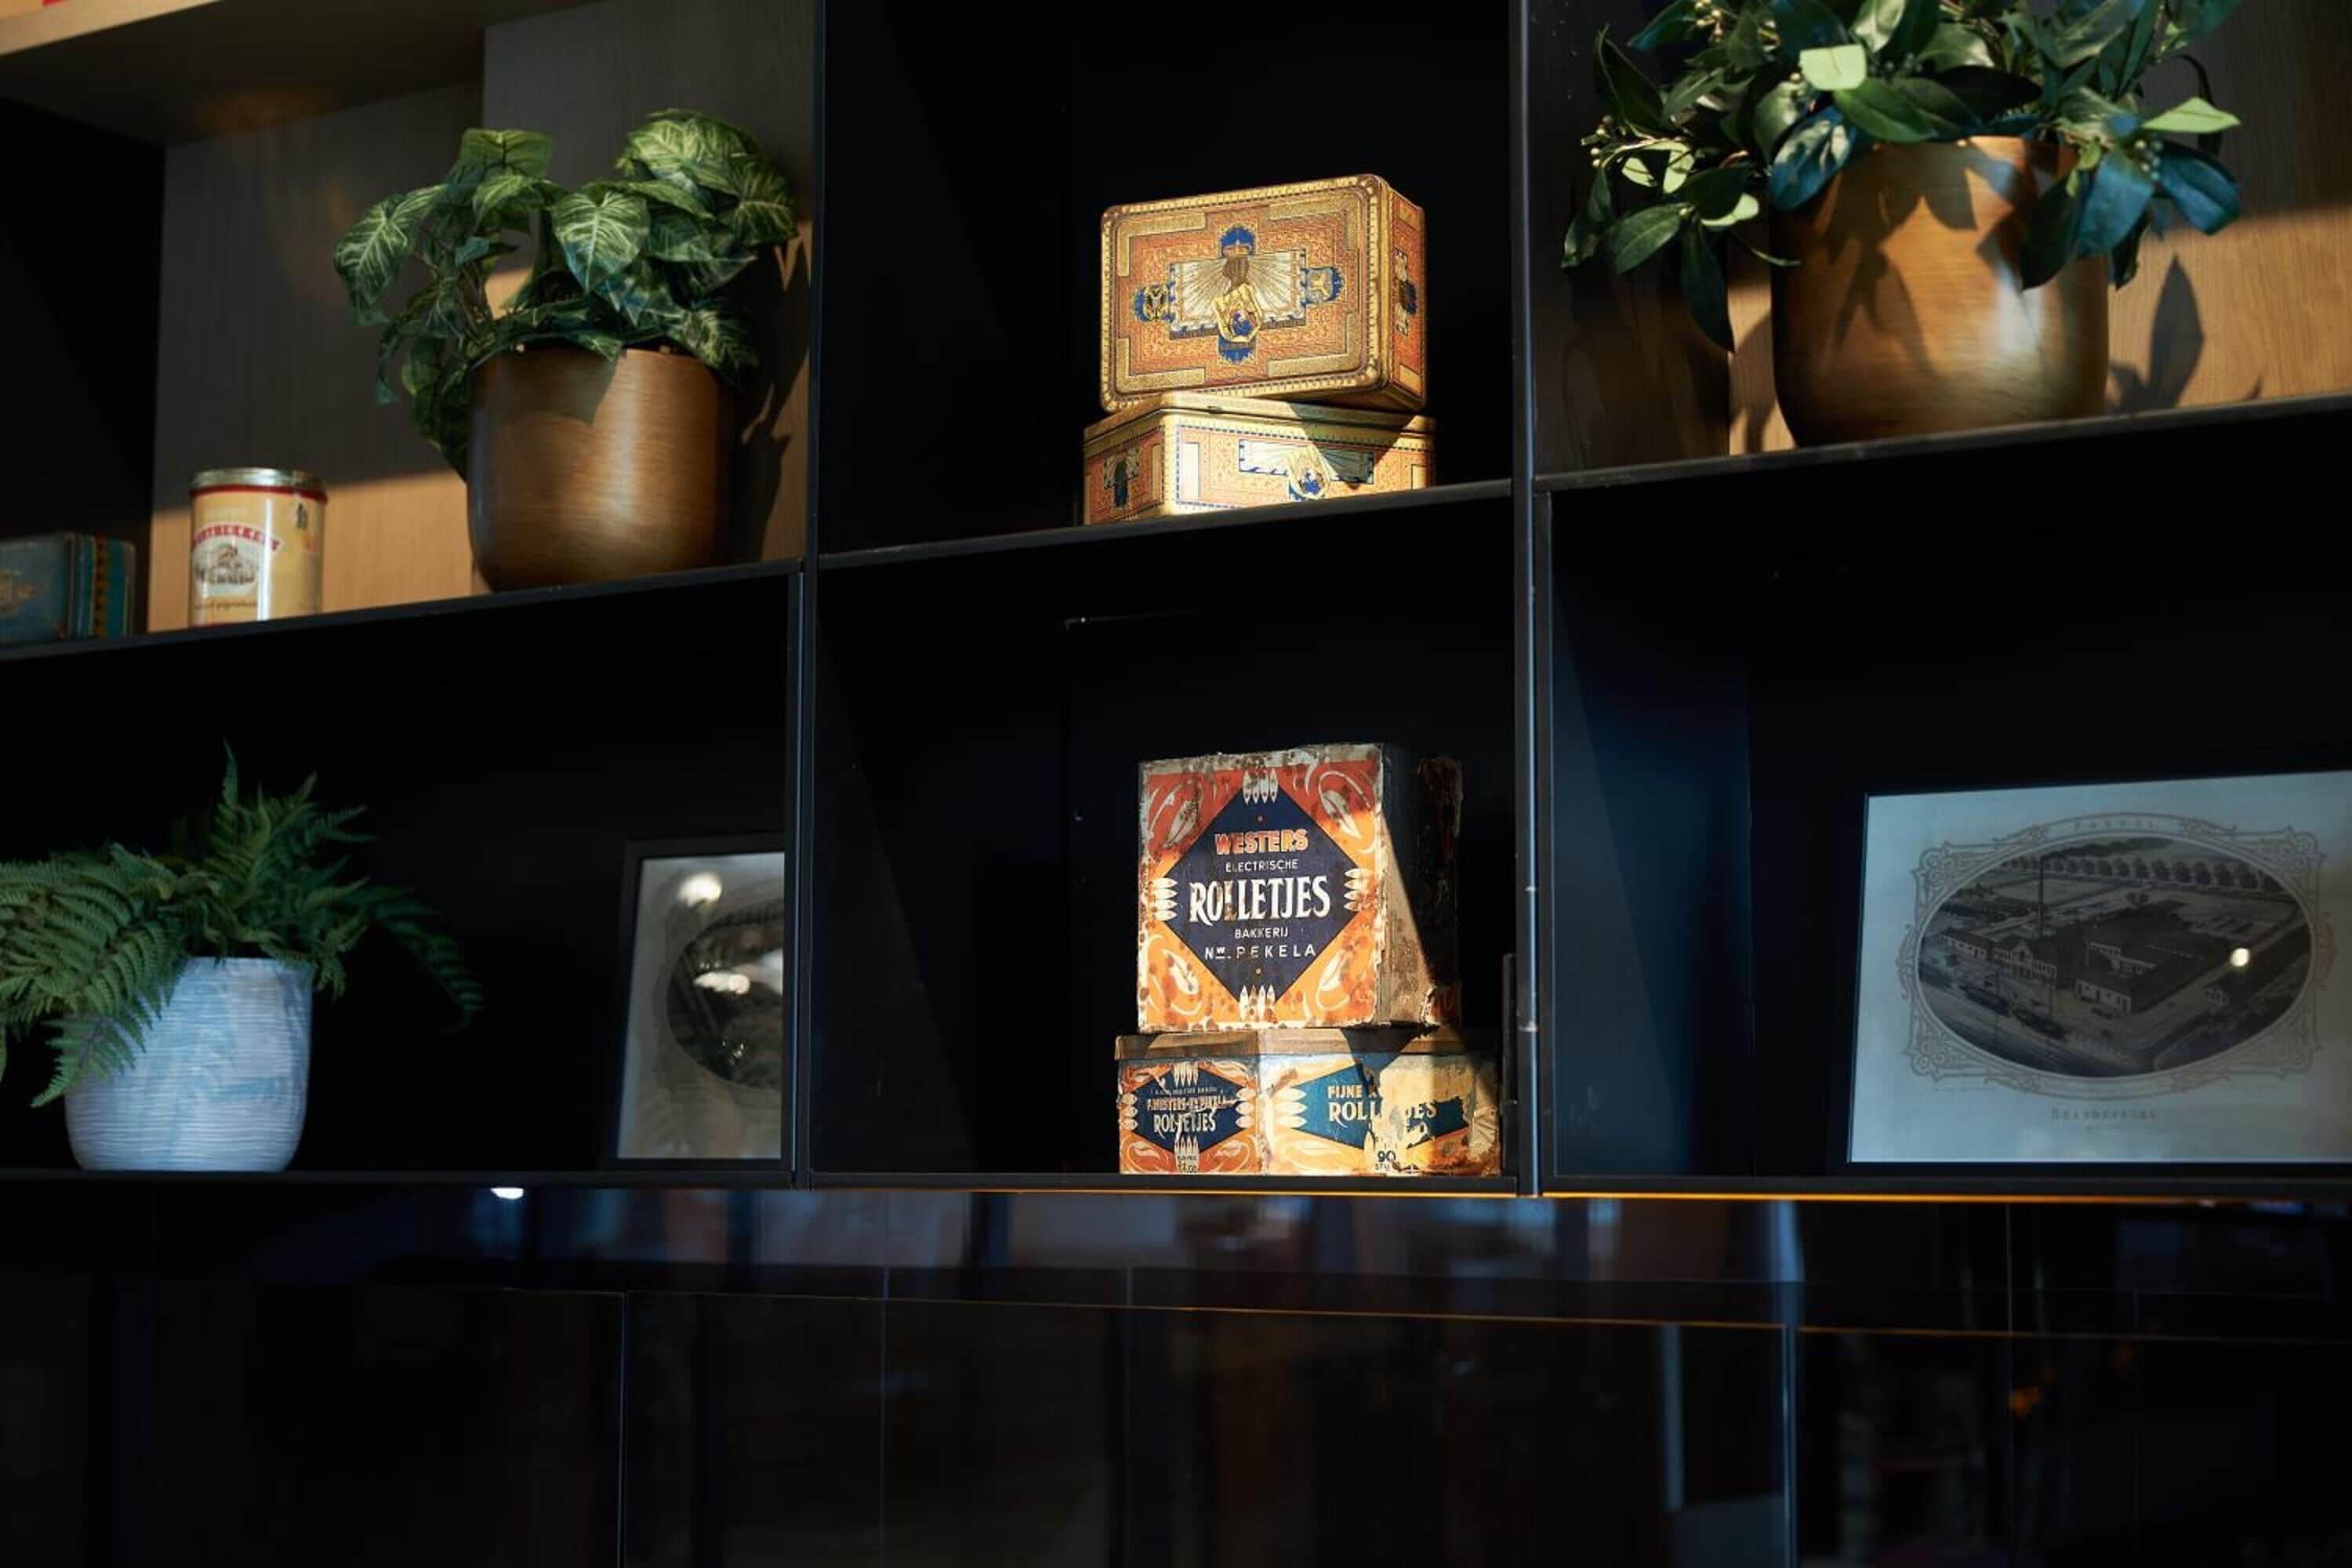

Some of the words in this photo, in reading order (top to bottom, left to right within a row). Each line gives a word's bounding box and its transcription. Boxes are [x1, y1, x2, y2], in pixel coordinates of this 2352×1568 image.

[1214, 828, 1308, 855] WESTERS
[1225, 858, 1299, 873] ELECTRISCHE
[1189, 875, 1331, 927] ROLLETJES
[1234, 927, 1289, 938] BAKKERIJ
[1236, 943, 1316, 959] PEKELA
[1327, 1085, 1363, 1099] FIJNE
[1377, 1150, 1397, 1162] 90
